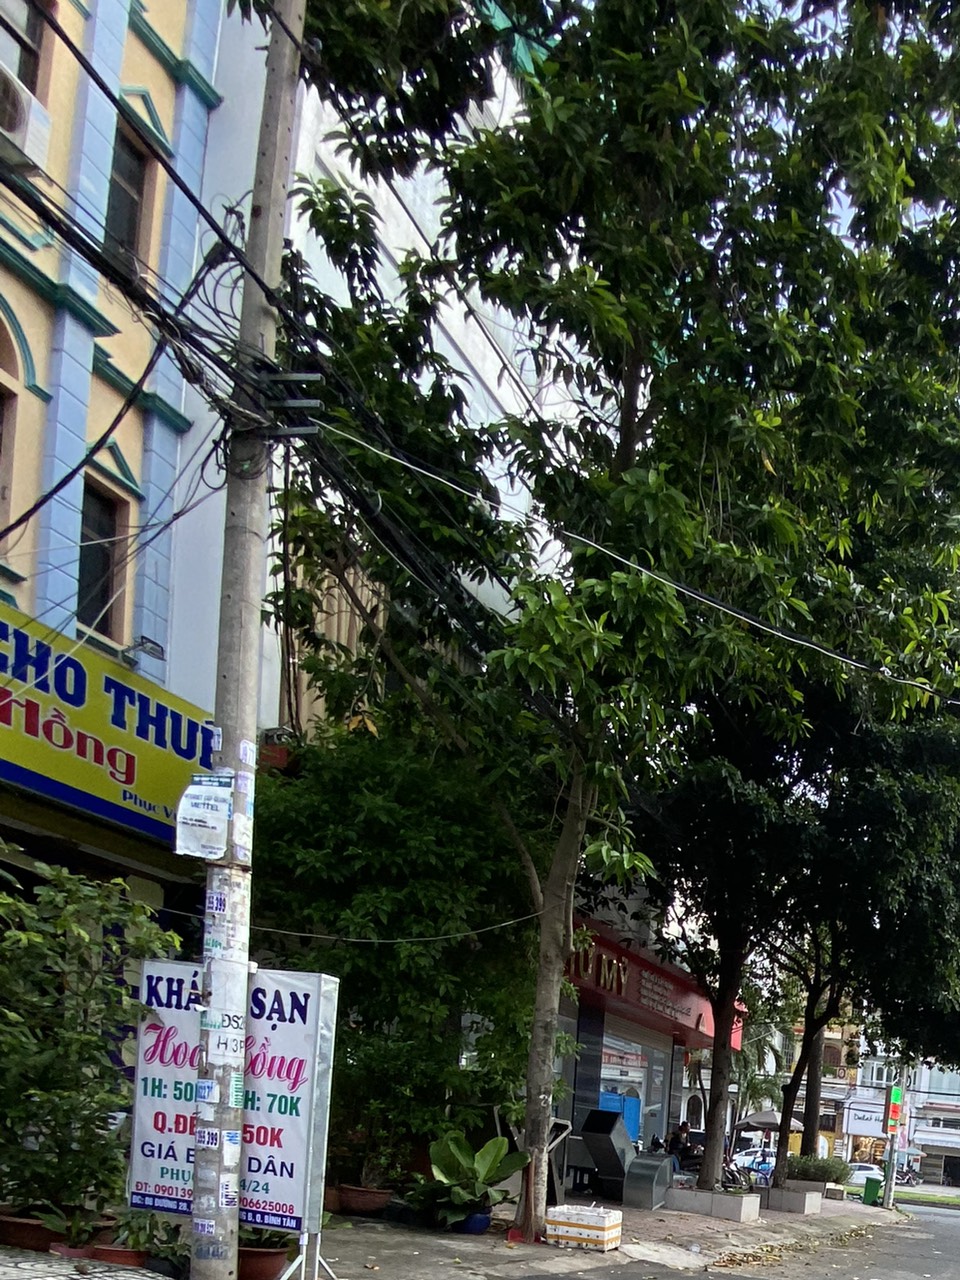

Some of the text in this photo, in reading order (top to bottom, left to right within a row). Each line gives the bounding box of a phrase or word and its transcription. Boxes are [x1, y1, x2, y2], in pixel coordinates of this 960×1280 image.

[0, 686, 137, 786] Hồng
[145, 970, 311, 1031] KHÁ SẠN
[141, 1077, 168, 1099] 1H:
[173, 1081, 197, 1102] 50
[244, 1090, 261, 1111] H:
[267, 1093, 302, 1117] 70K
[141, 1141, 178, 1161] GIÁ
[248, 1155, 294, 1179] DÂN
[135, 1182, 295, 1215] ĐT: 090139 06625008
[160, 1167, 193, 1186] PHỤ
[239, 1179, 271, 1195] 4/24
